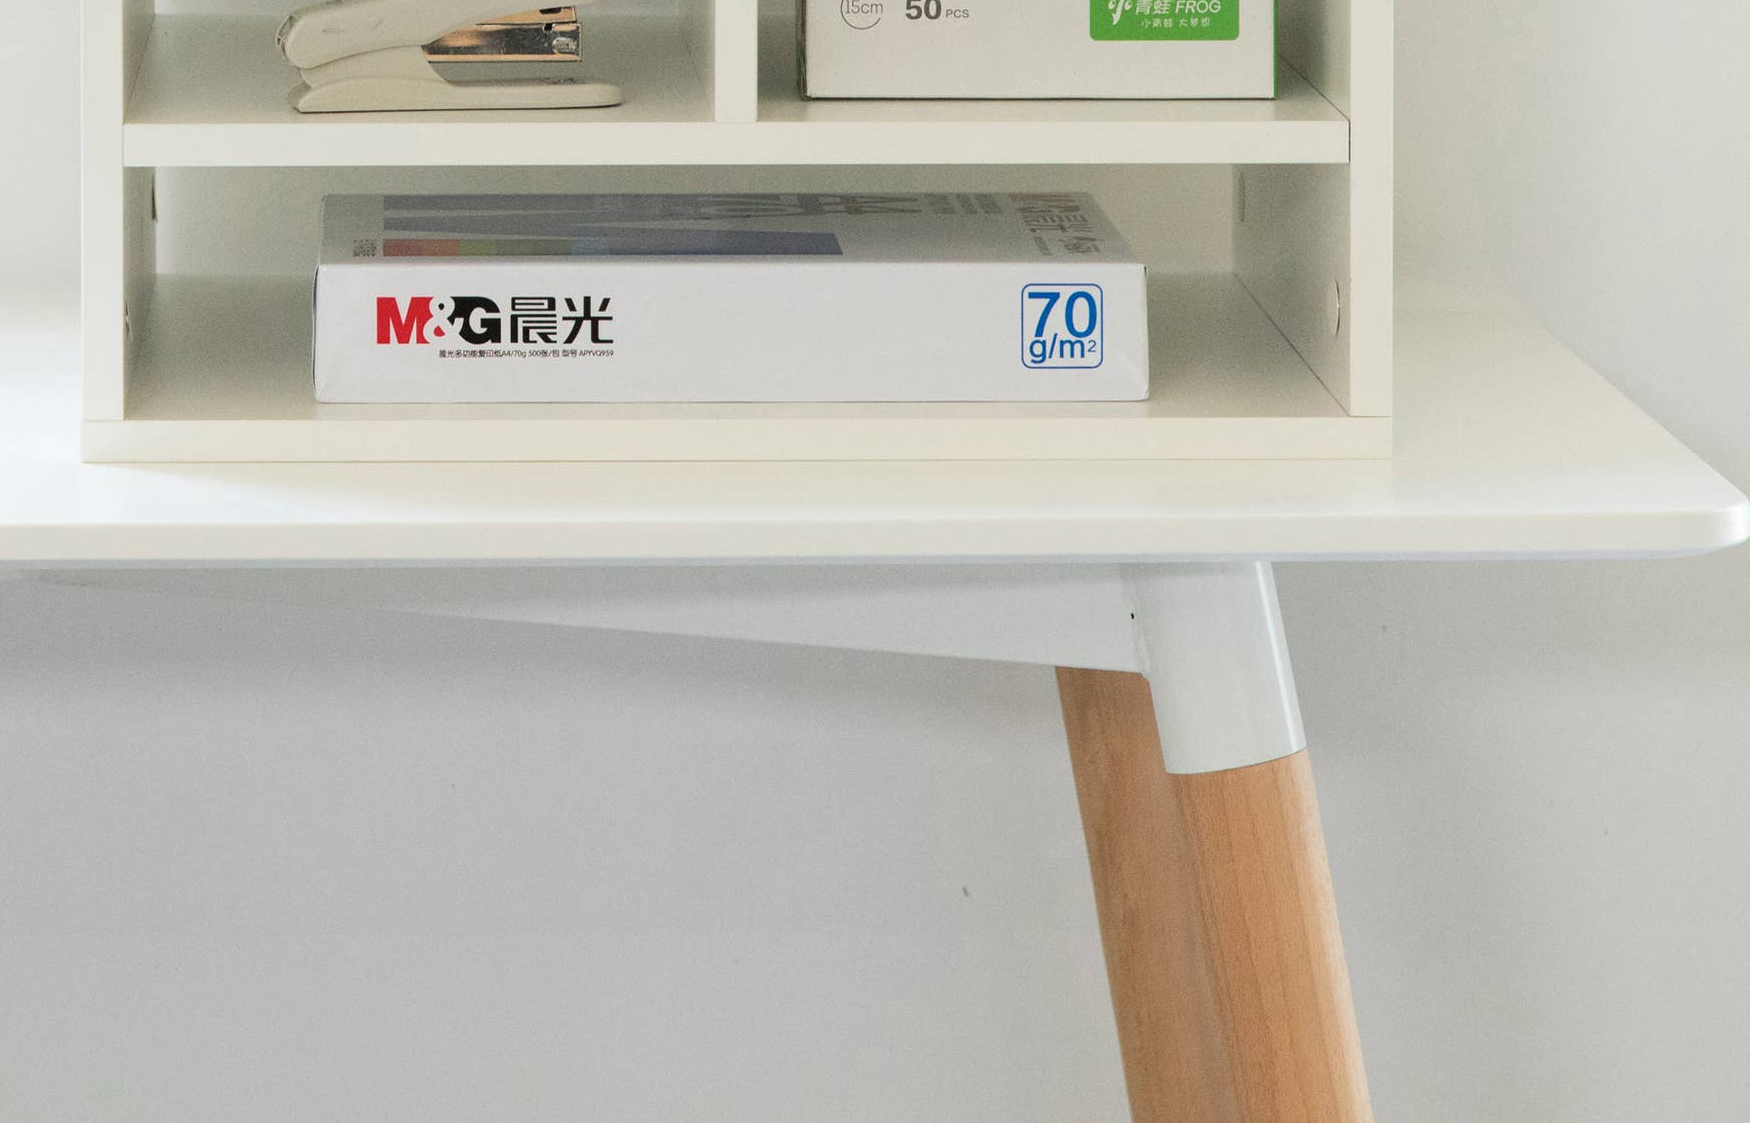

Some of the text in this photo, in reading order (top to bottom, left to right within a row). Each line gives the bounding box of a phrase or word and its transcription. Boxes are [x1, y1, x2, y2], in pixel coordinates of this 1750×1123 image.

[844, 0, 884, 15] 15cm
[945, 8, 970, 19] PCS
[1175, 0, 1222, 14] FROG
[509, 296, 614, 344] 晨光
[1027, 290, 1098, 339] 70
